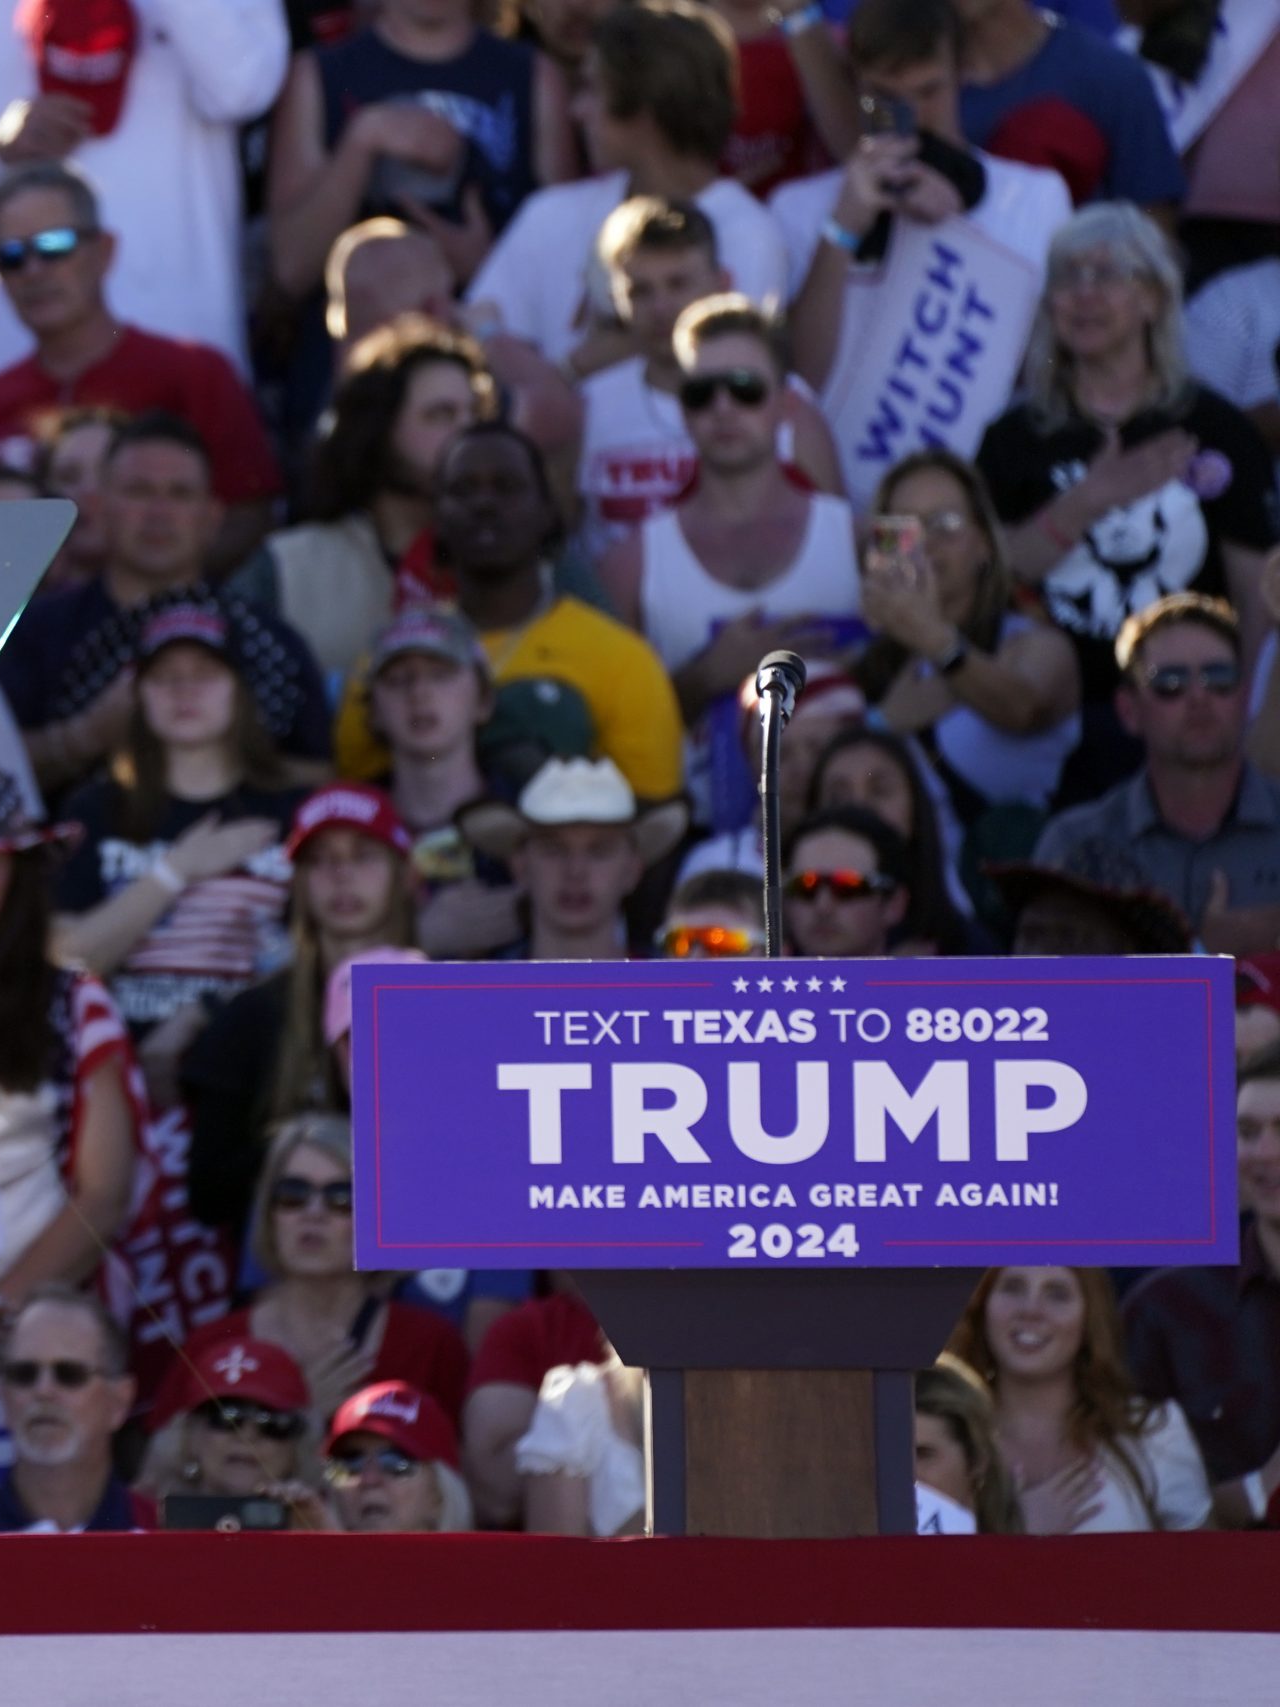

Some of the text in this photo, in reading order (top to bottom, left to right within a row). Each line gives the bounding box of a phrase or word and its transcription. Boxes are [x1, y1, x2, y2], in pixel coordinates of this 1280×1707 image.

[856, 240, 962, 460] WITCH
[533, 1007, 1049, 1045] TEXT TEXAS TO 88022
[496, 1059, 1088, 1165] TRUMP
[529, 1182, 1058, 1209] MAKE AMERICA GREAT AGAIN!
[727, 1223, 860, 1259] 2024
